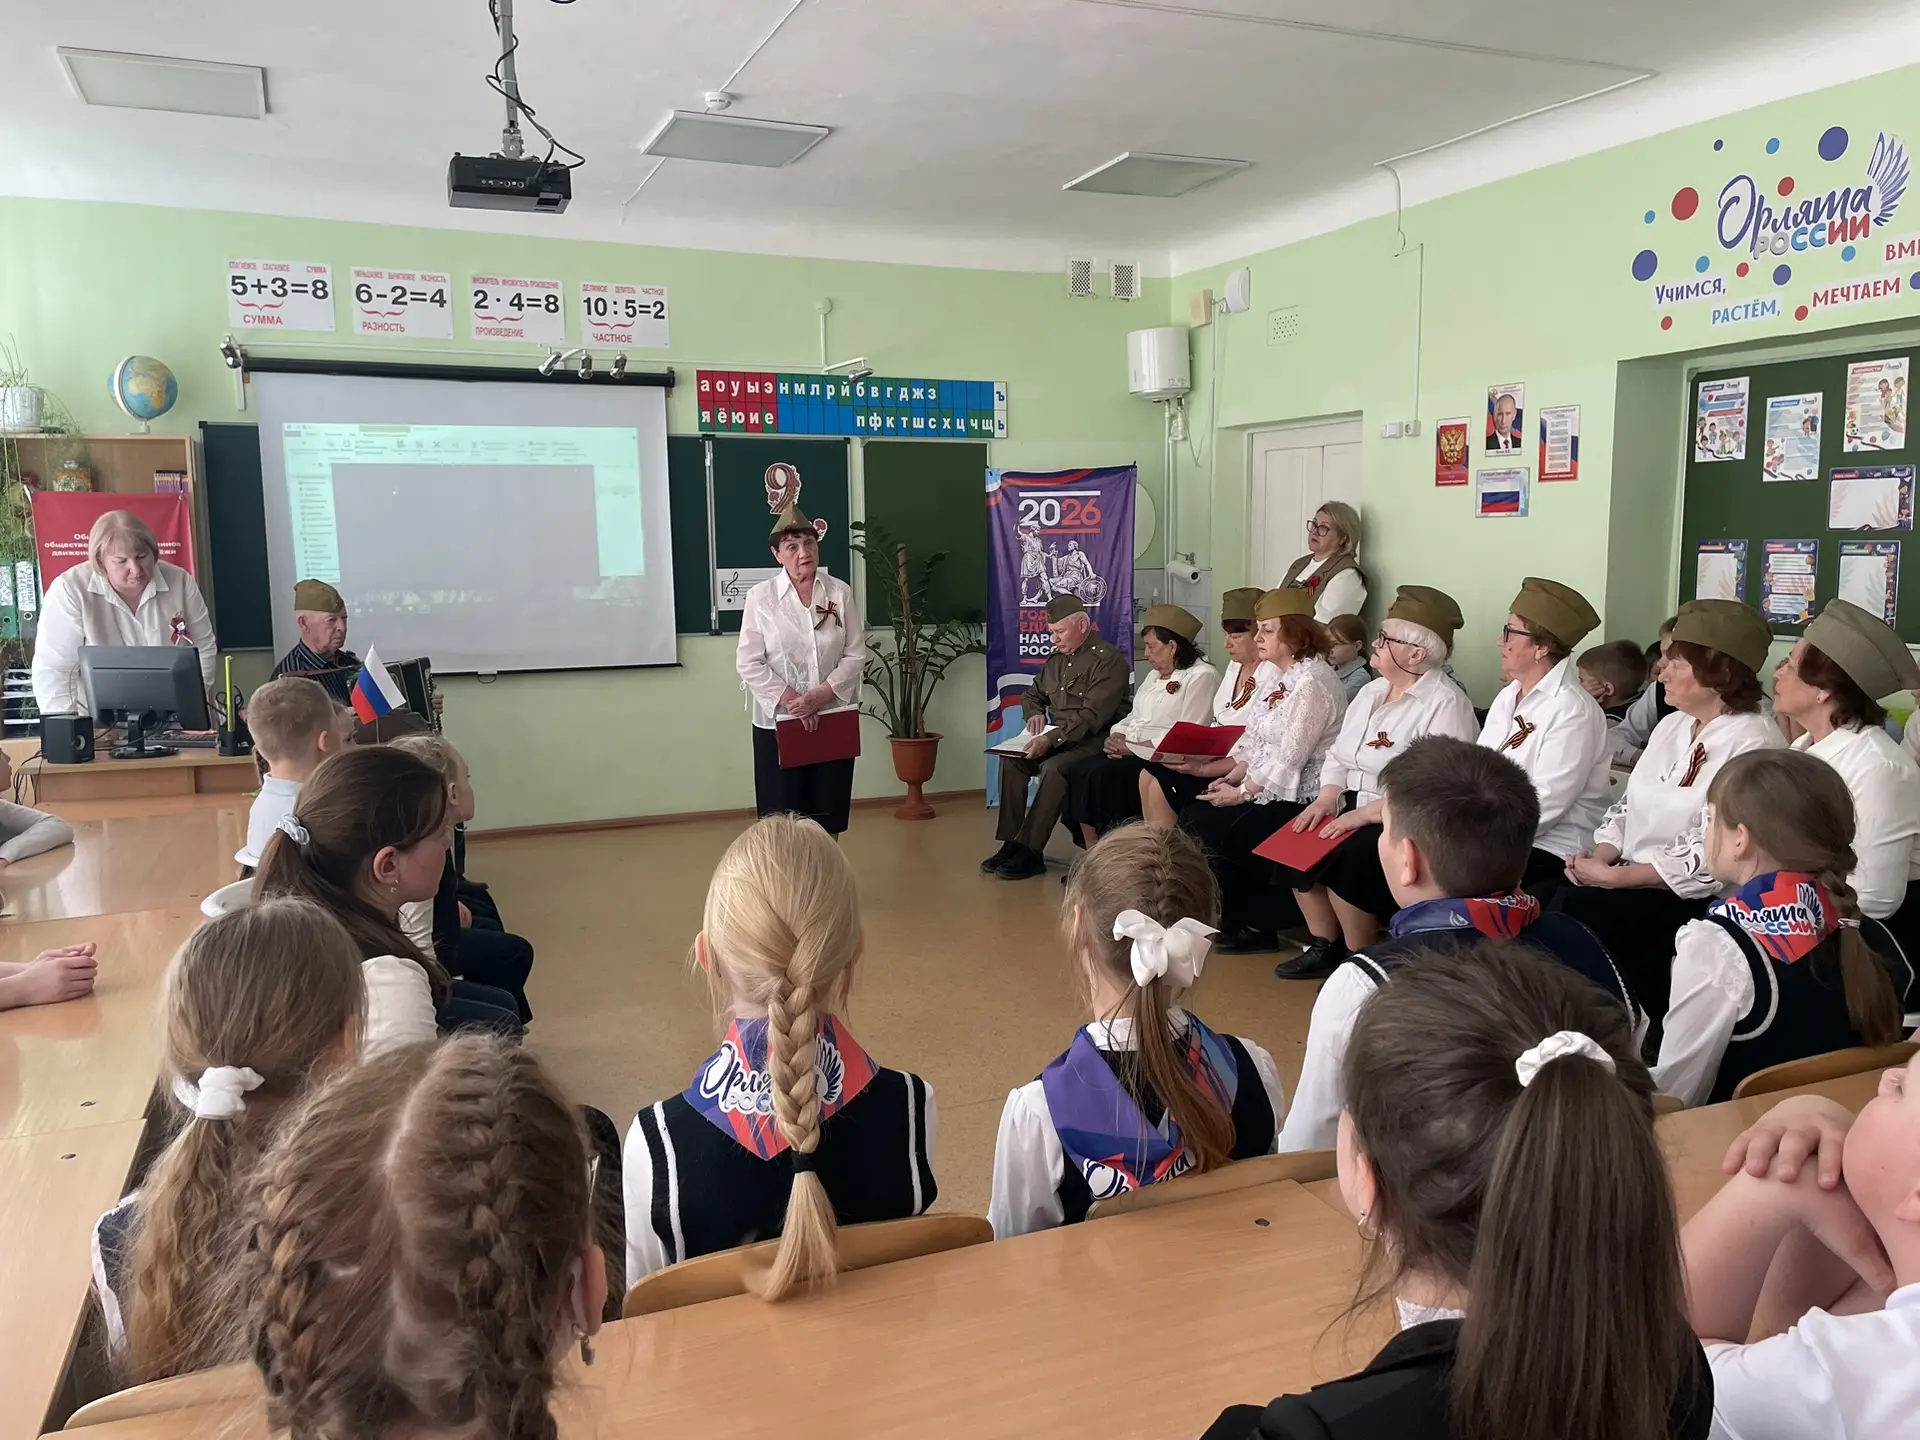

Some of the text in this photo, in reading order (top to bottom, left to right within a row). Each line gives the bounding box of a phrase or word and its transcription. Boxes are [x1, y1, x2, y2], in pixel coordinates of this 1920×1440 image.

[1717, 174, 1874, 253] Орлята
[1753, 213, 1870, 260] РОССИИ
[1812, 277, 1901, 307] МЕЧТАЕМ
[243, 314, 283, 326] СУММА
[1711, 299, 1781, 325] РАСТЁМ,
[362, 321, 405, 333] РАЗНОСТЬ
[475, 327, 524, 338] ПРОИЗВЕДЕНИЕ
[592, 332, 633, 343] ЧАСТНОЕ
[1018, 498, 1102, 527] 2026
[1019, 609, 1049, 622] ГОД
